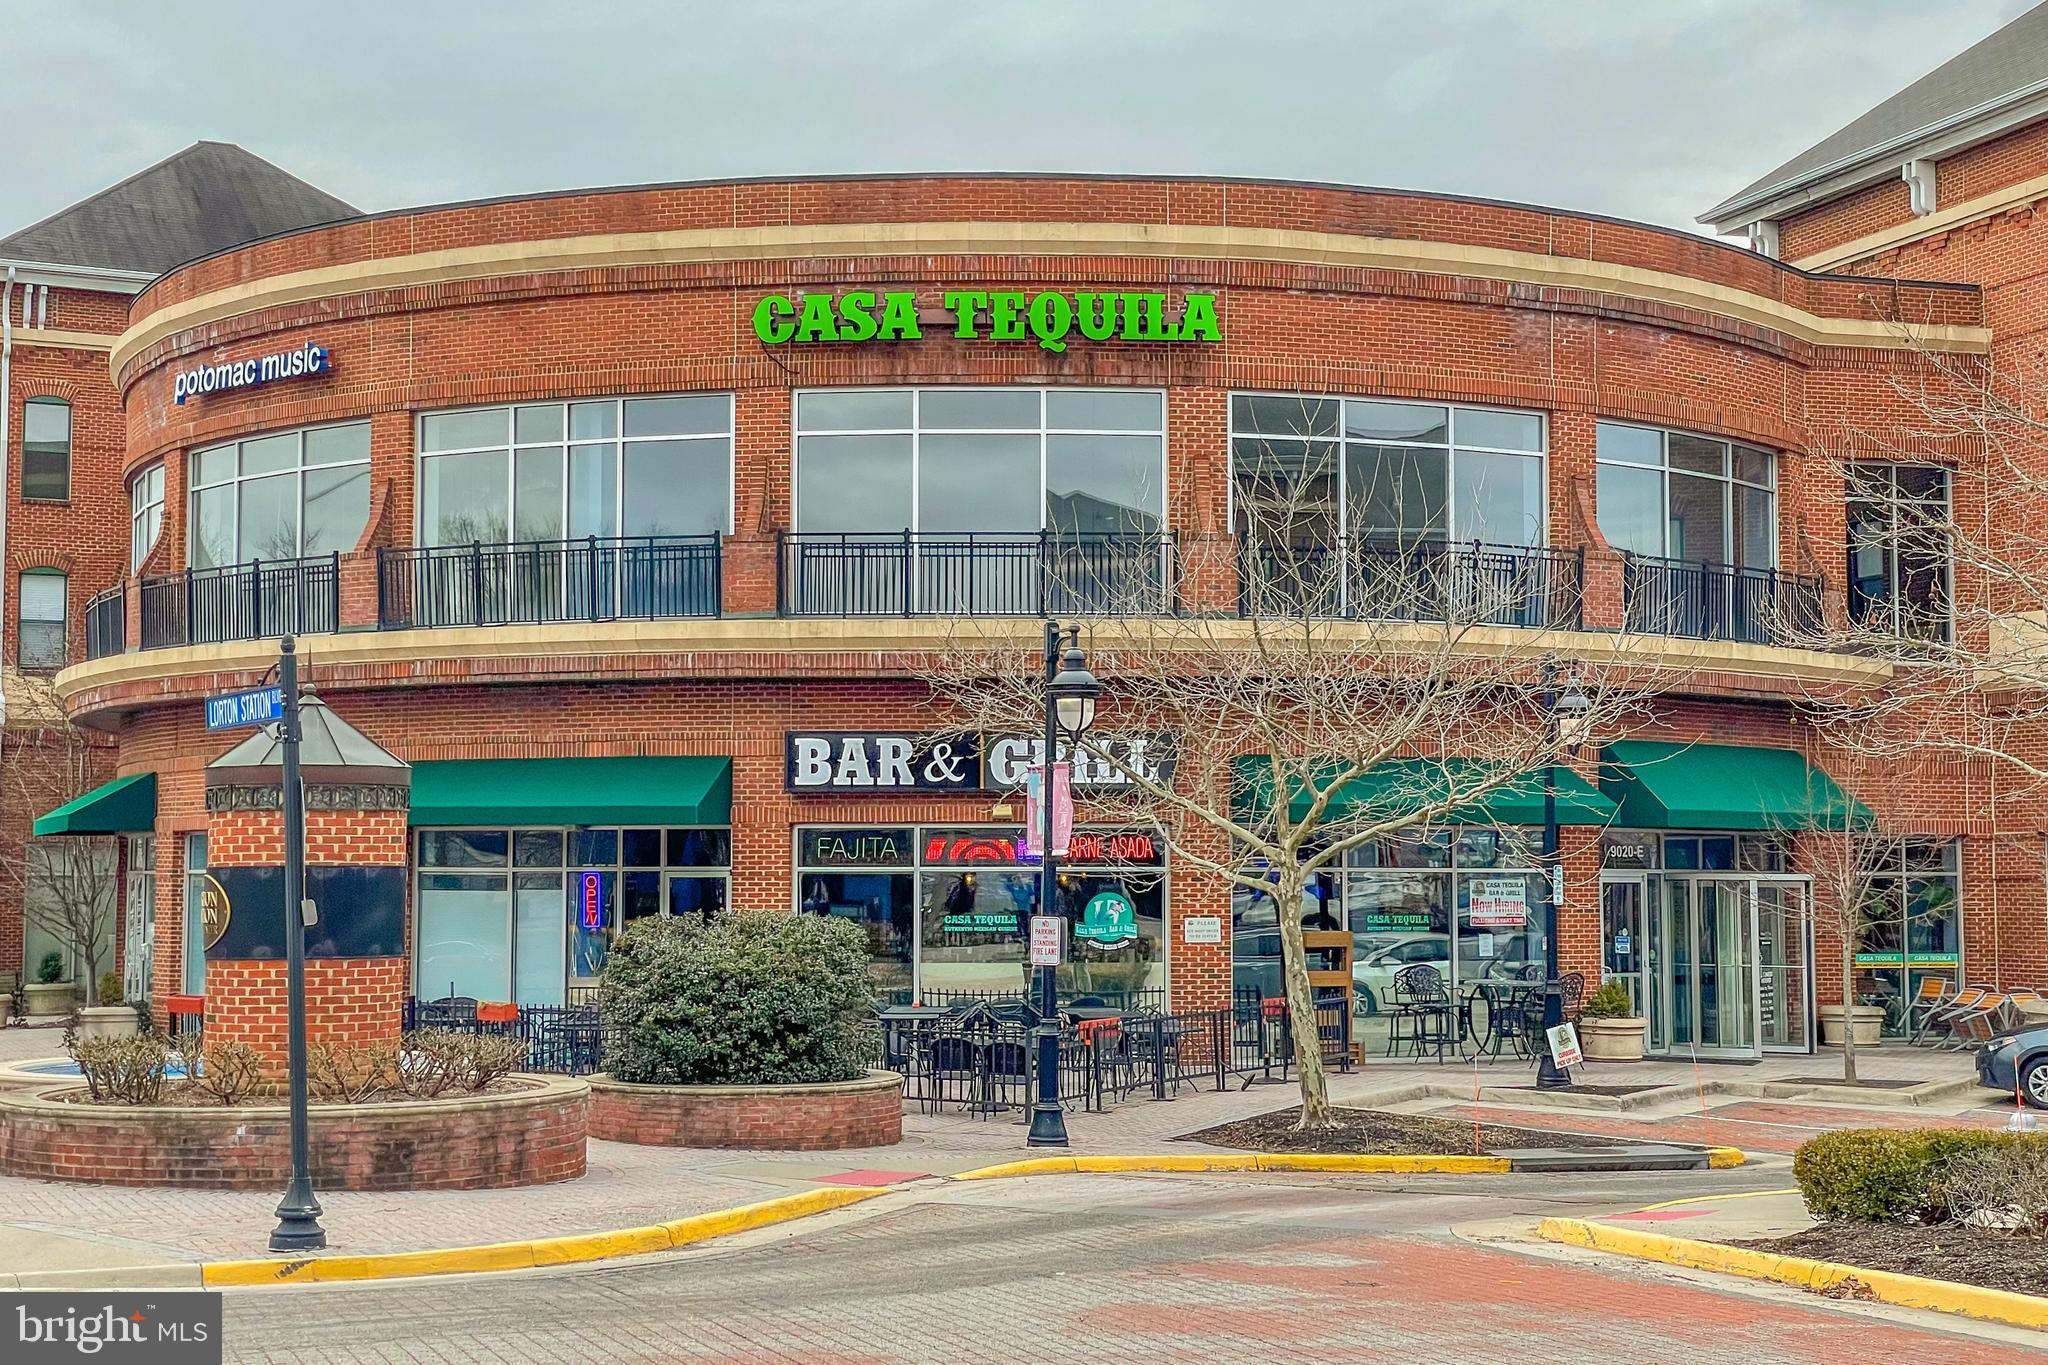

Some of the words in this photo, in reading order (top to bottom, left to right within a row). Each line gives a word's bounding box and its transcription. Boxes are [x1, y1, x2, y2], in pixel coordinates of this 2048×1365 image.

[751, 291, 923, 344] CASA
[944, 291, 1223, 354] TEQUILA
[174, 359, 256, 404] potomac
[261, 342, 321, 381] music
[209, 697, 239, 727] LORTON
[240, 691, 272, 721] STATION
[794, 737, 915, 786] BAR
[924, 743, 965, 783] &
[816, 836, 898, 860] FAJITA
[1063, 836, 1105, 858] ARNE
[1109, 836, 1154, 858] ASADA
[1610, 845, 1645, 858] 9020-E
[585, 875, 598, 926] OPEN
[944, 915, 971, 924] CASA
[973, 915, 1018, 926] TEQUILA
[1034, 928, 1056, 936] PARKING
[1041, 920, 1050, 928] NO
[1367, 915, 1391, 924] CASA
[1392, 915, 1430, 926] TEQUILA
